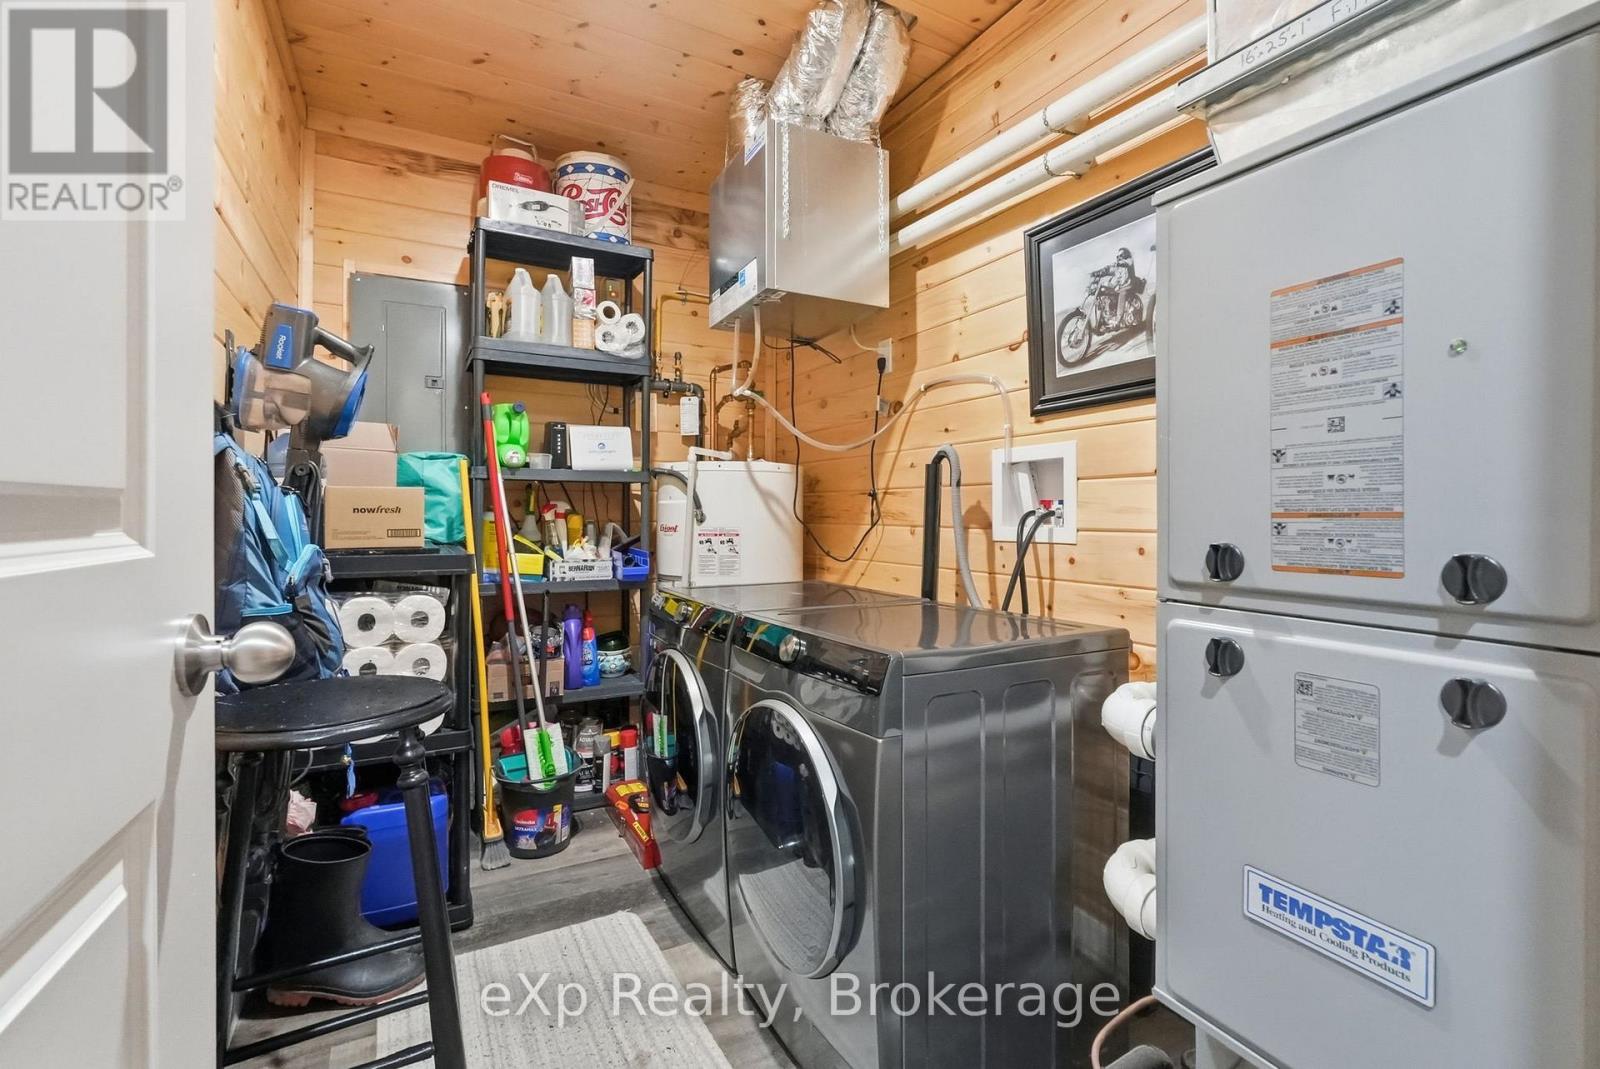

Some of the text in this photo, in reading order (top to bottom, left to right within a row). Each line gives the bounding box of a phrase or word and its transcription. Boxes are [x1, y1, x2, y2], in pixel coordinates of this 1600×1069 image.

[492, 183, 519, 194] DREMEL
[352, 505, 402, 514] nowfresh
[660, 523, 679, 533] Giant
[1258, 882, 1412, 972] TEMPSTAR
[1261, 904, 1411, 983] Heating and Cooling Products
